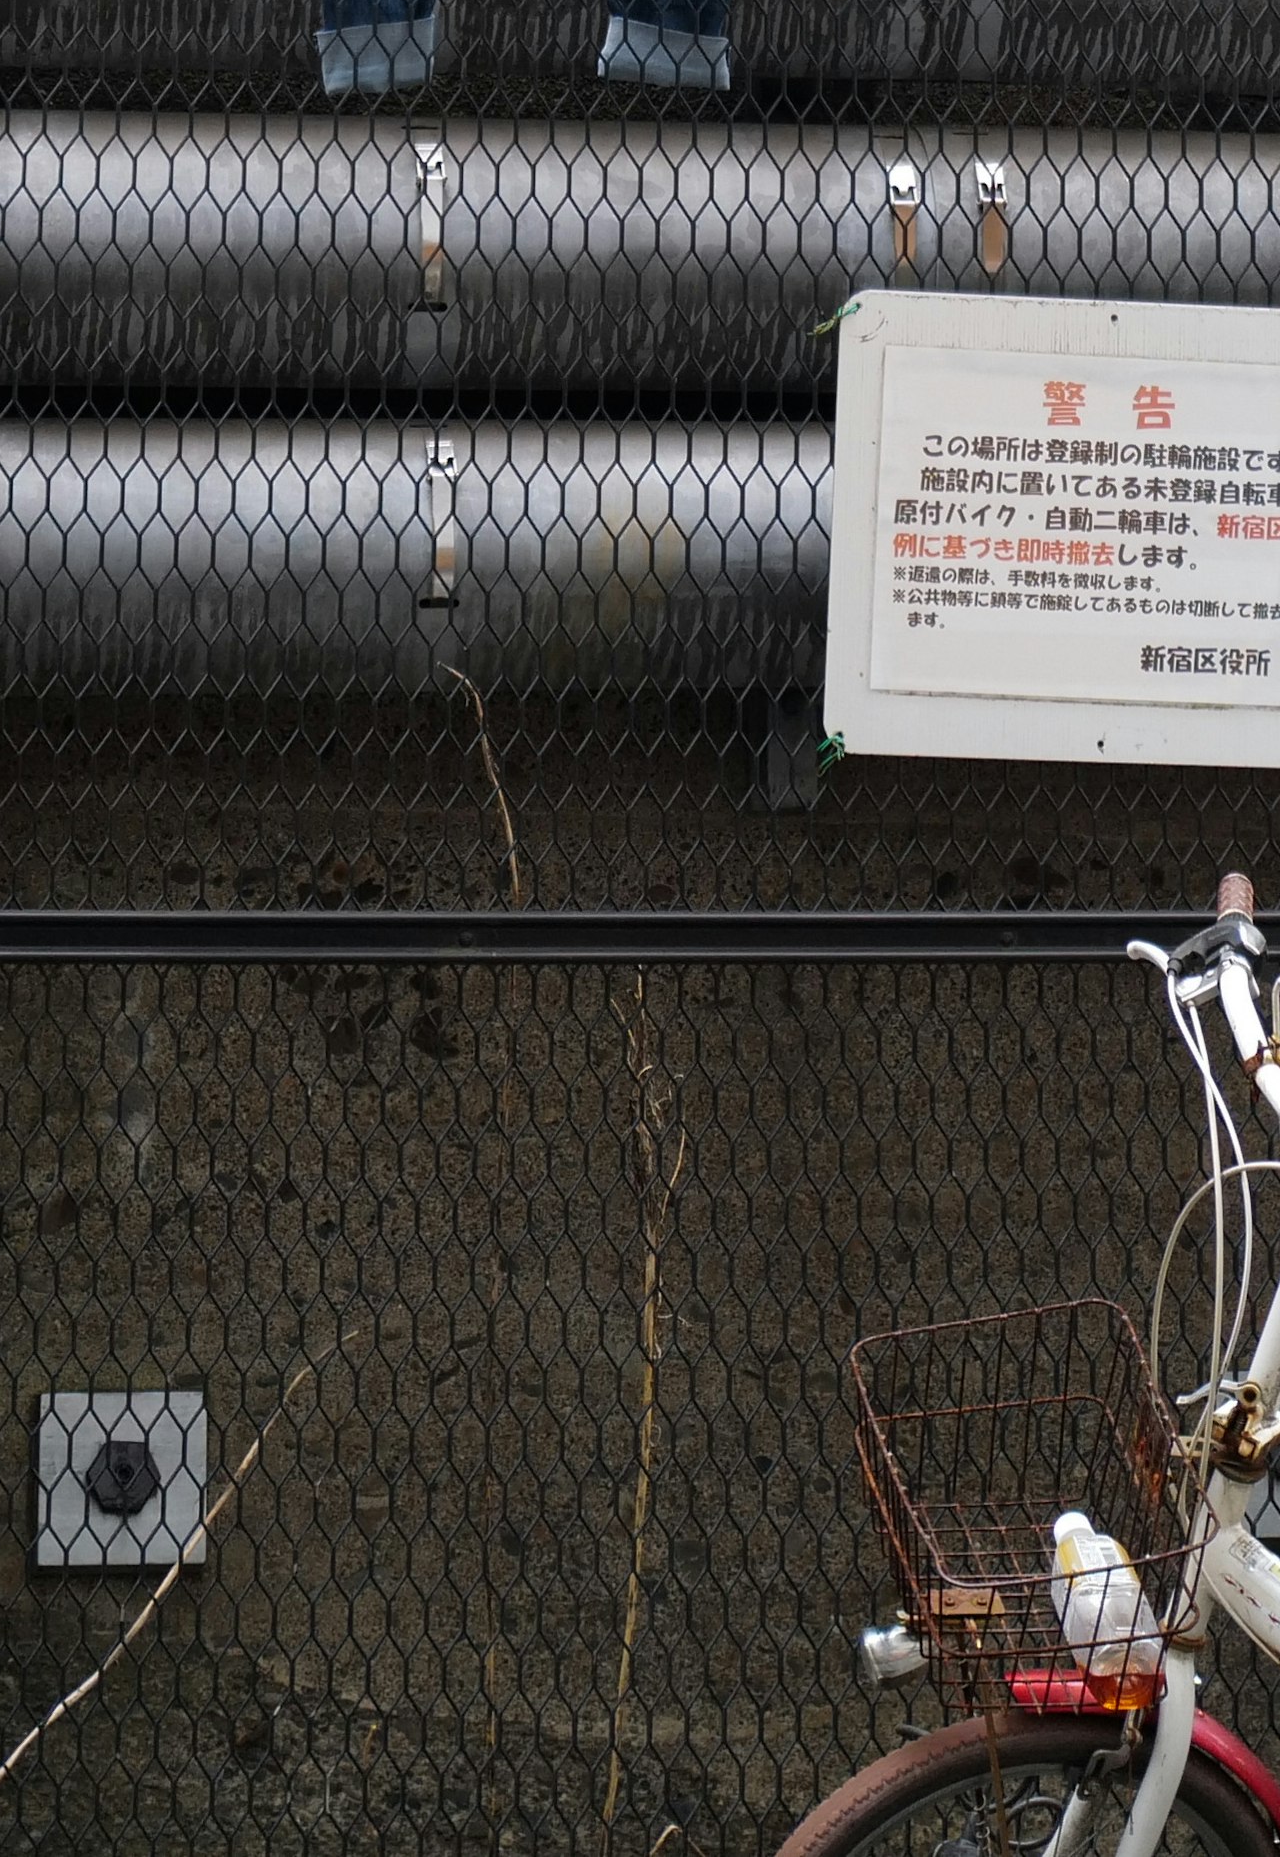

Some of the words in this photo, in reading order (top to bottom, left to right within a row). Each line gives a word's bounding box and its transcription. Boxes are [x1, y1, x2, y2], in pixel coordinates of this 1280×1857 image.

[907, 611, 946, 629] ます。
[1140, 645, 1272, 677] 新宿区役所
